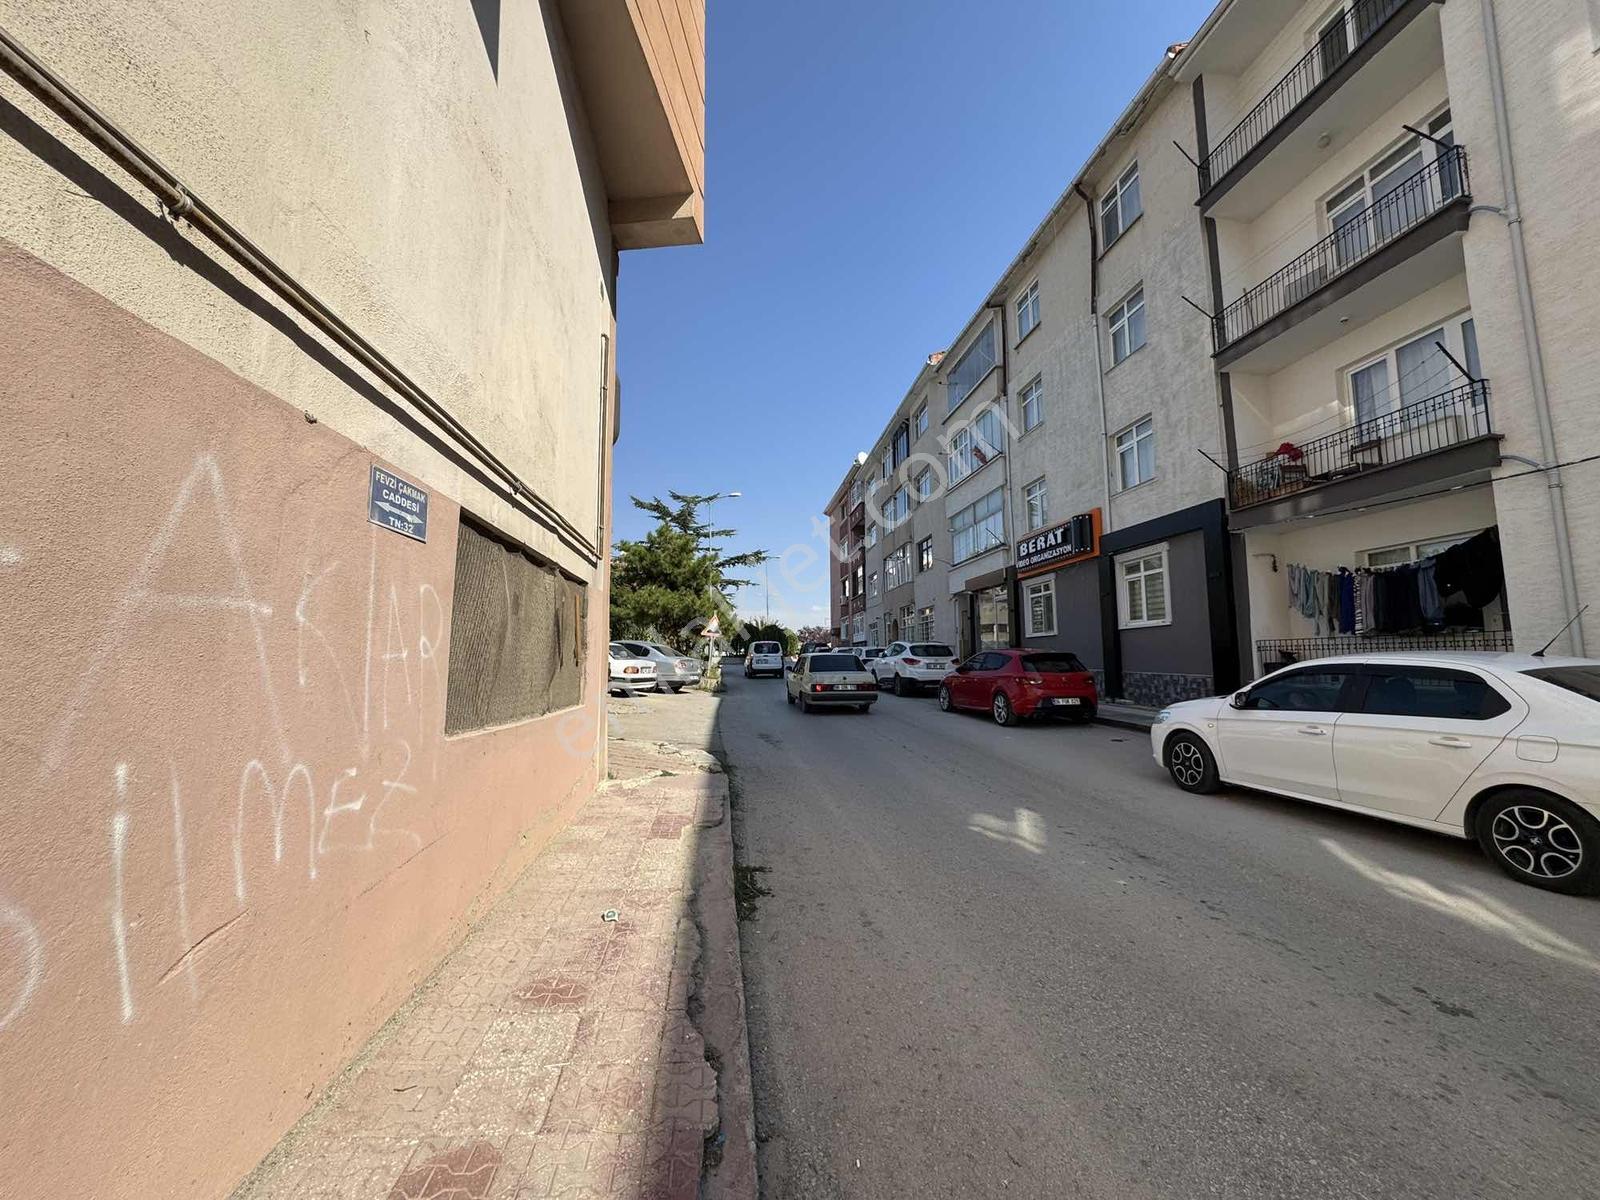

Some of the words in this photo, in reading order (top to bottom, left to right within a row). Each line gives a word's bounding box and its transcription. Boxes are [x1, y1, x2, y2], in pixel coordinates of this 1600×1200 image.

[375, 471, 397, 490] FEVZİ
[398, 482, 426, 503] ÇAKMAK
[388, 516, 415, 533] TN:32
[1019, 528, 1064, 557] BERAT
